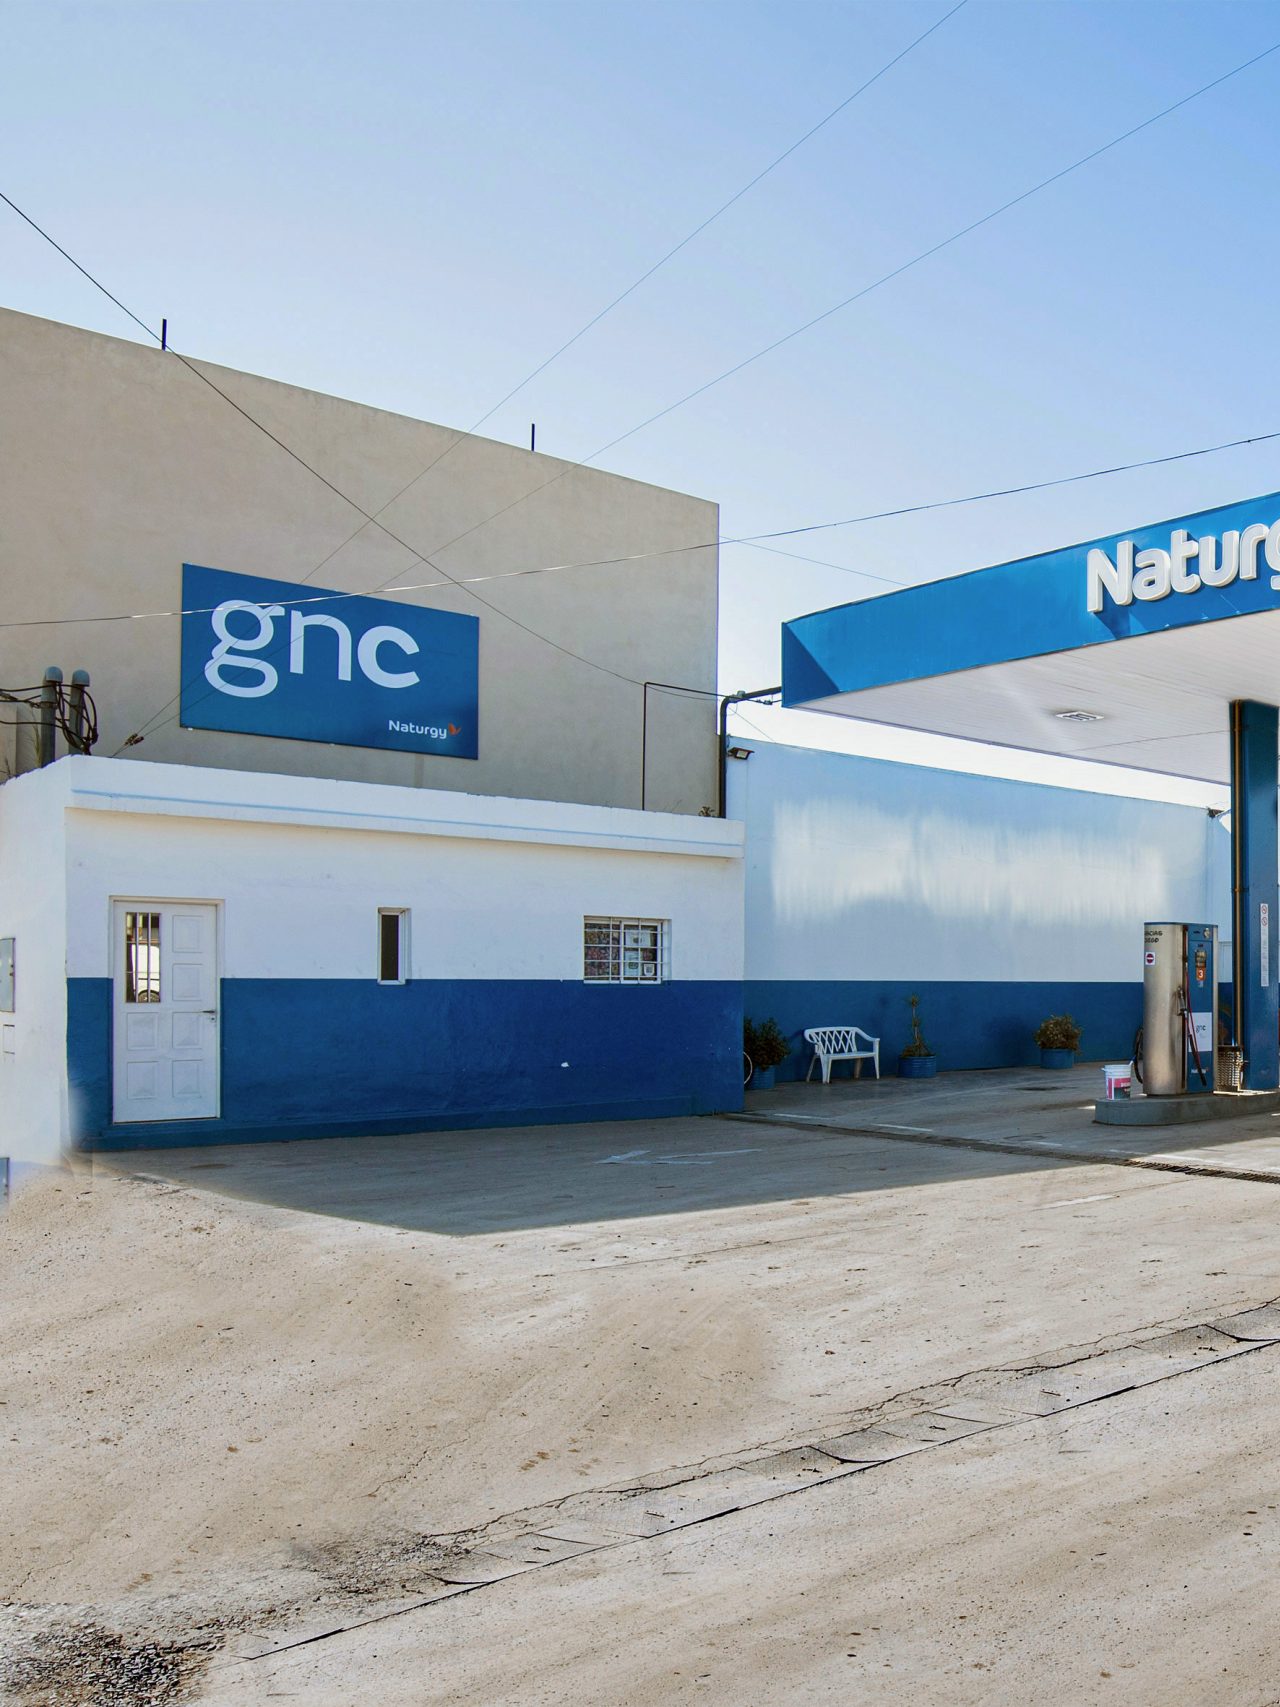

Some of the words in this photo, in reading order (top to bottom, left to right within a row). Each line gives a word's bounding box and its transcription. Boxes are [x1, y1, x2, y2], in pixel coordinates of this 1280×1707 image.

[204, 599, 420, 698] gnc
[388, 719, 448, 739] Naturgy
[1198, 969, 1204, 978] 3
